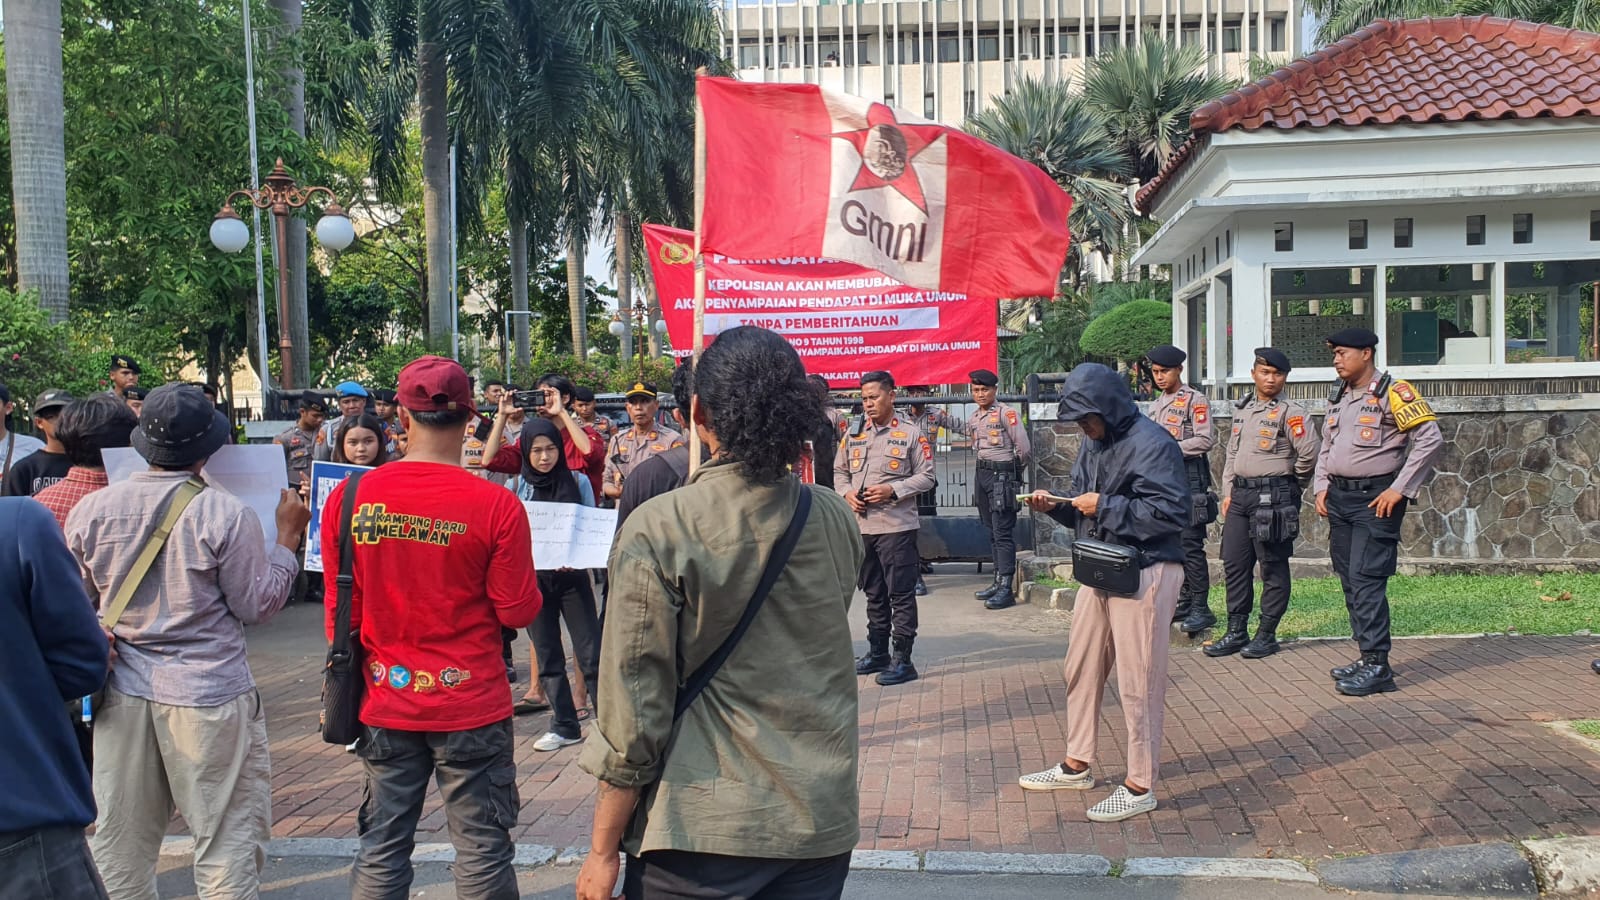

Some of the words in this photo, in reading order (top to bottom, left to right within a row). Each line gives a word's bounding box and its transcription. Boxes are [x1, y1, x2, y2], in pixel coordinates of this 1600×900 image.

[708, 279, 784, 291] KEPOLISIAN
[786, 280, 823, 291] AKAN
[826, 275, 904, 290] MEMBUBAR
[706, 297, 797, 310] PENYAMPAIAN
[799, 295, 867, 308] PENDAPAT
[868, 294, 882, 305] DI
[885, 292, 924, 305] MUKA
[926, 291, 967, 302] UMUM
[740, 318, 783, 329] TANPA
[785, 315, 899, 329] PEMBERITAHUAN
[788, 337, 803, 346] NO
[803, 337, 810, 346] 9
[810, 336, 843, 346] TAHUN
[843, 336, 865, 345] 1998
[796, 345, 857, 356] NYAMPAIKAN
[858, 344, 911, 355] PENDAPAT
[911, 343, 920, 353] DI
[921, 342, 949, 352] MUKA
[950, 340, 981, 350] UMUM
[1167, 408, 1185, 416] POLRI
[1360, 405, 1381, 414] POLRI
[887, 439, 908, 447] POLRI
[464, 449, 483, 457] POLR
[376, 512, 432, 528] KAMPUNG
[434, 519, 467, 534] BARU
[375, 524, 450, 546] MELAWAN
